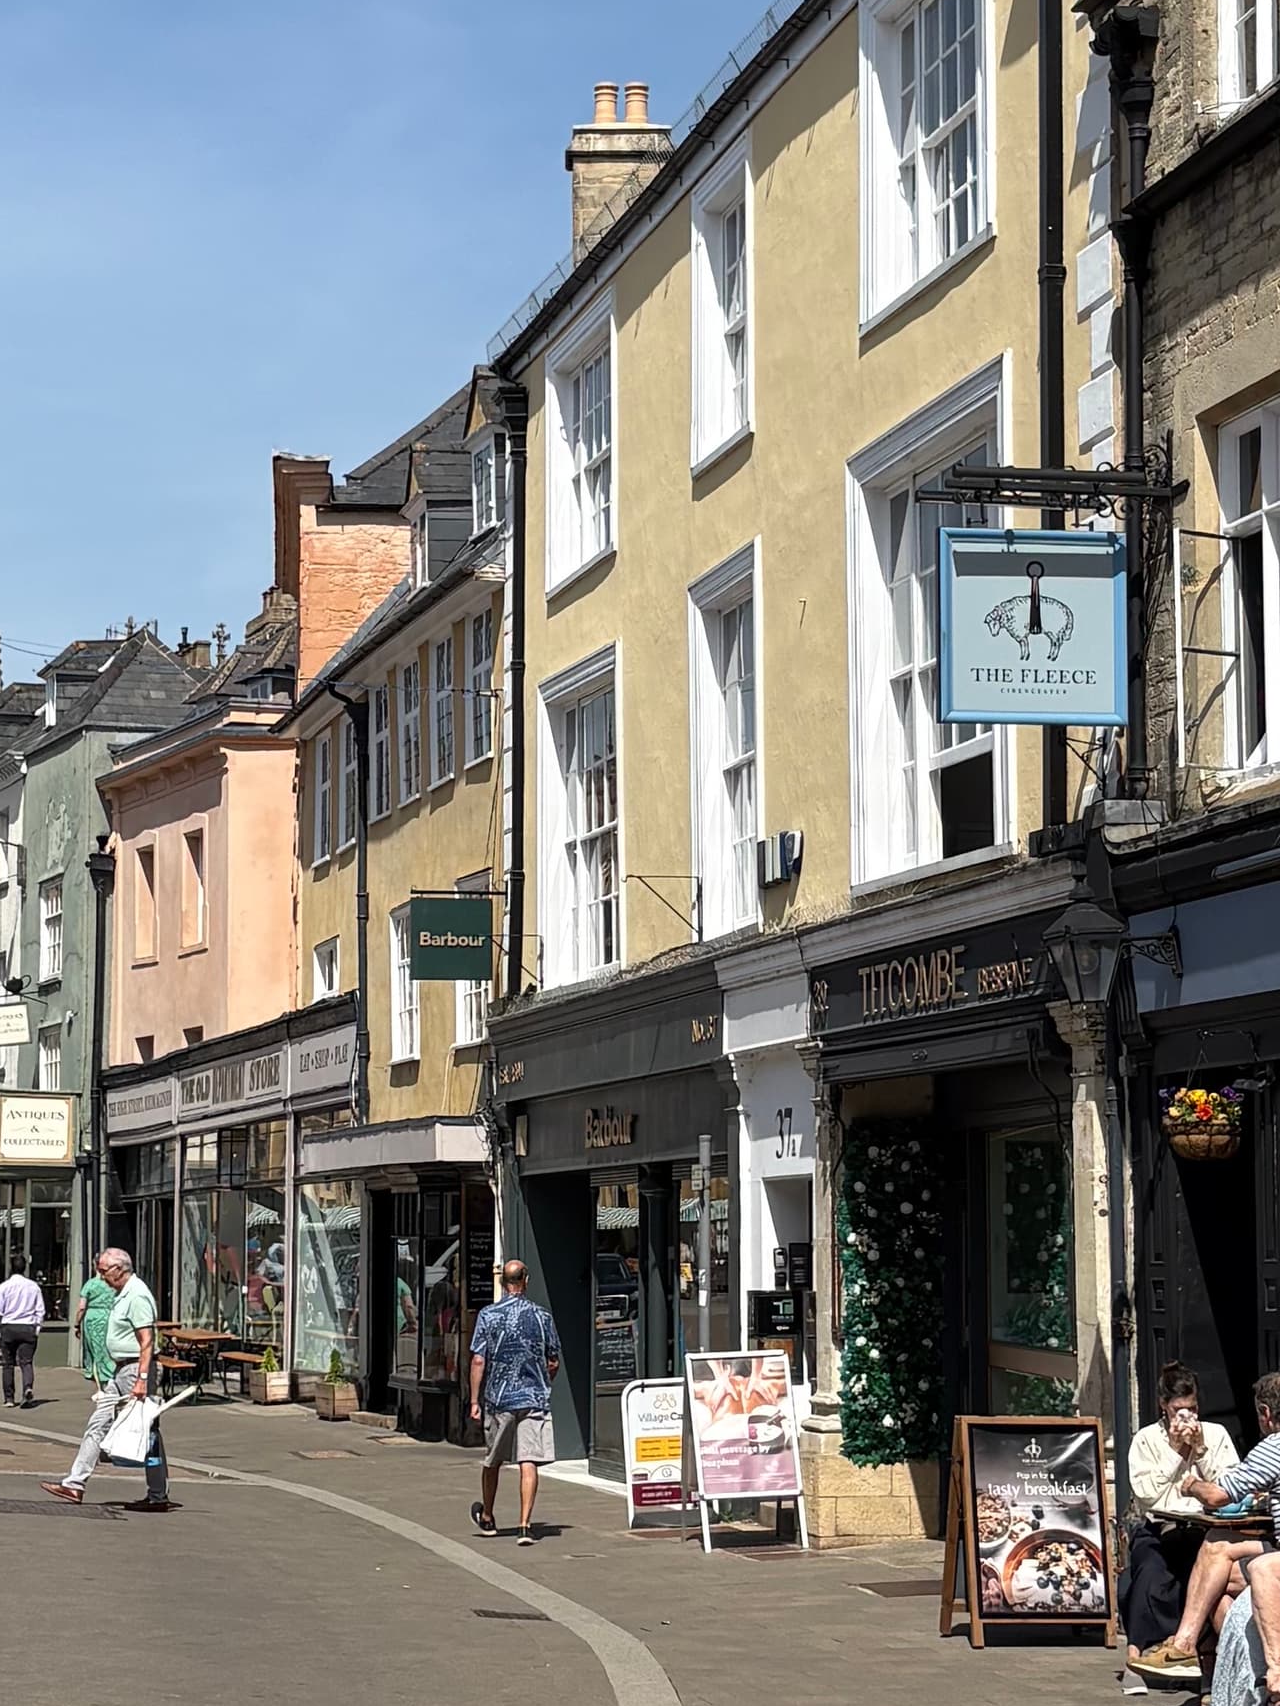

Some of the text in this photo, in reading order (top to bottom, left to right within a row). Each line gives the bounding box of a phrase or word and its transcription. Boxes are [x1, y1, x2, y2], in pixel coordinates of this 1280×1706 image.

[970, 667, 1097, 684] THE FLEECE
[419, 931, 486, 947] Barbour
[858, 944, 969, 1017] TITCOMBE
[249, 1054, 281, 1093] STORE
[6, 1109, 65, 1121] ANTIQUES
[30, 1125, 40, 1134] &
[584, 1106, 634, 1149] Barbour
[3, 1138, 65, 1147] COLLECTABLES
[637, 1412, 669, 1423] Village
[987, 1479, 1089, 1499] tasty breakfast
